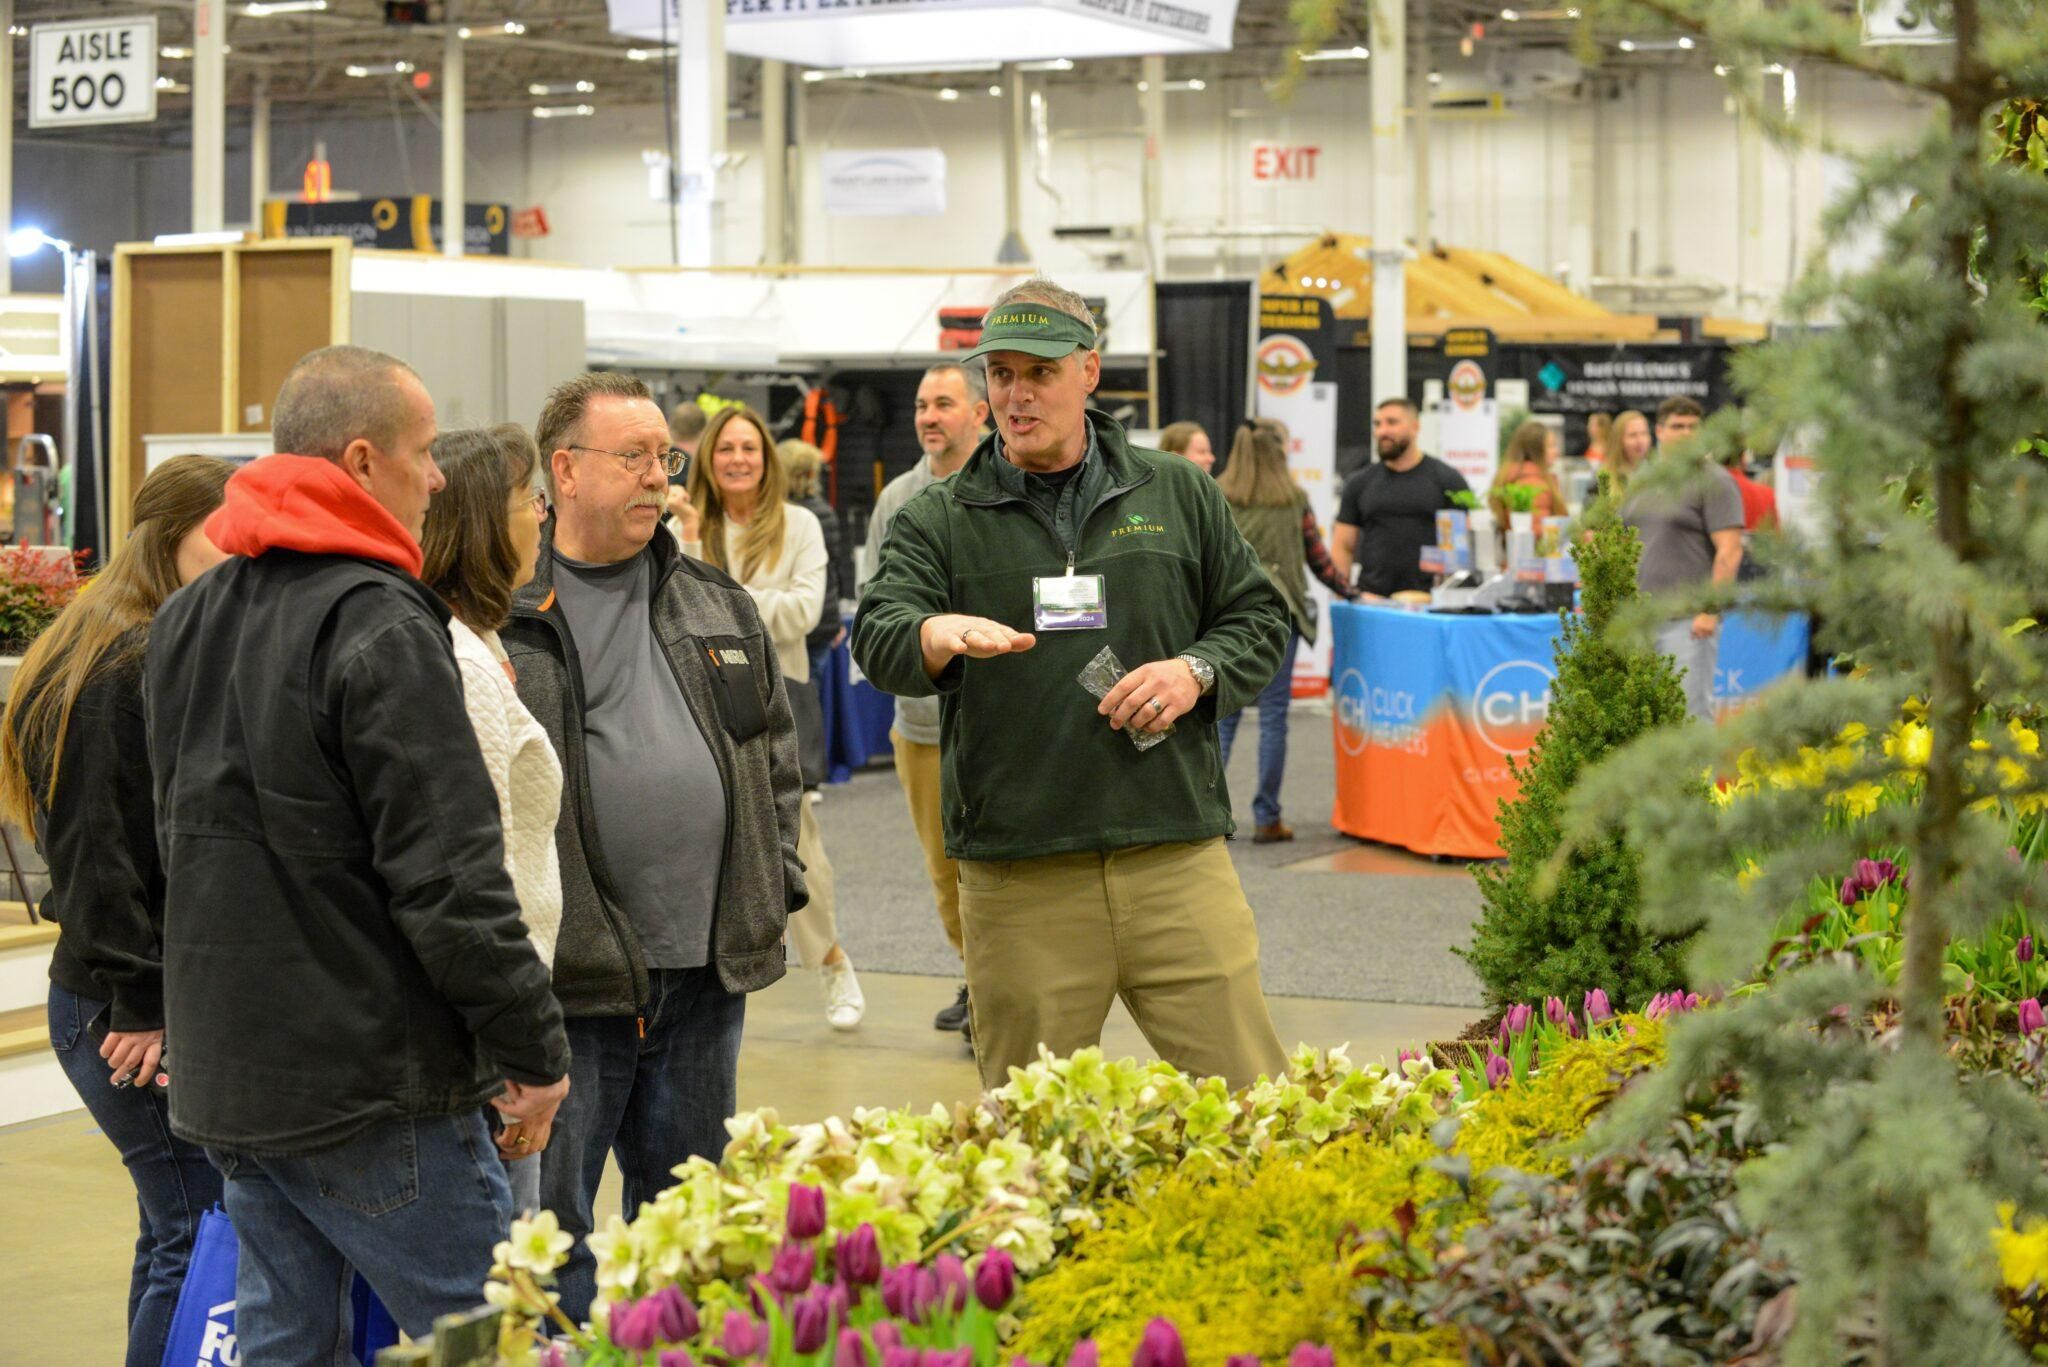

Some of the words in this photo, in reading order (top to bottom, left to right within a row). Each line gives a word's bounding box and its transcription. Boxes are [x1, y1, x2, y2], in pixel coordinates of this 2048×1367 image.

[58, 31, 130, 62] AISLE
[50, 72, 125, 112] 500
[1254, 146, 1322, 180] EXIT
[992, 313, 1049, 326] PREMIUM
[1111, 524, 1165, 537] PREMIUM
[1338, 695, 1366, 727] CH
[1372, 687, 1416, 719] CLICK
[1483, 690, 1551, 726] CH
